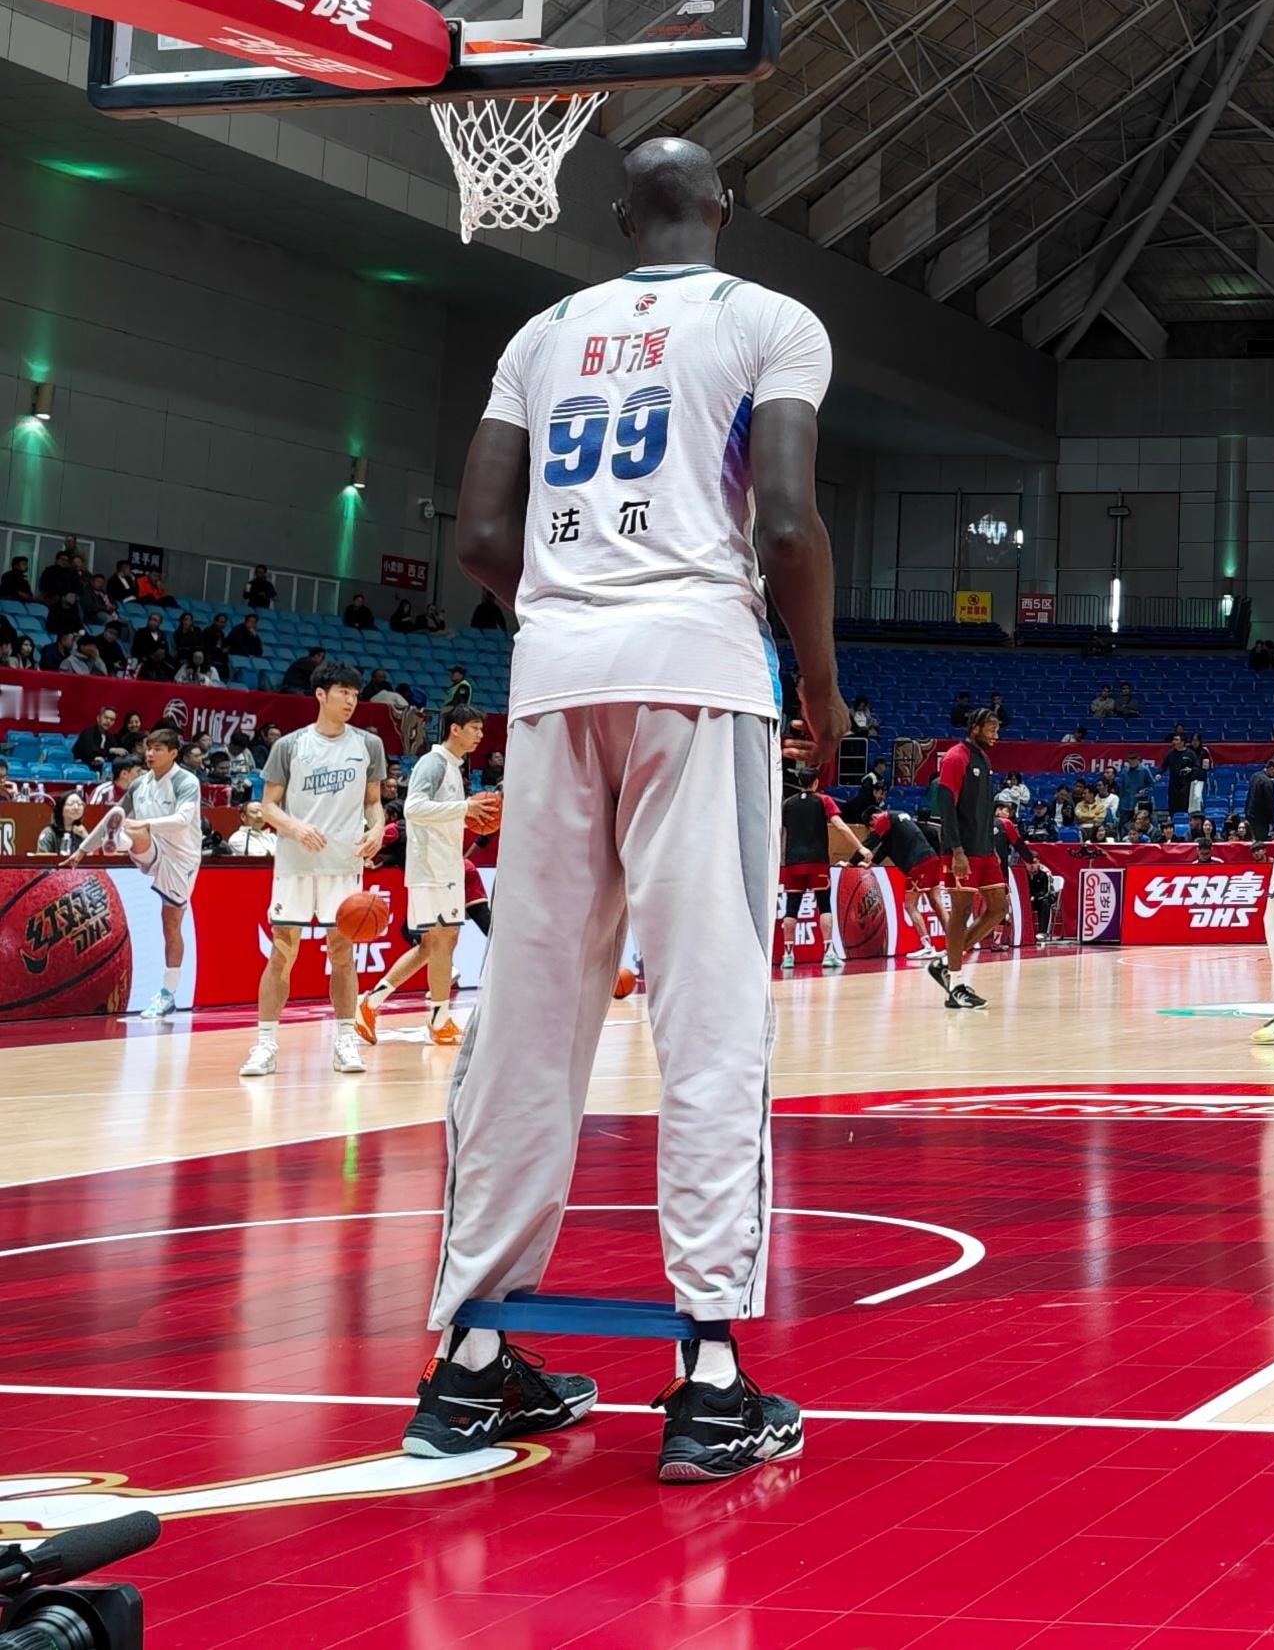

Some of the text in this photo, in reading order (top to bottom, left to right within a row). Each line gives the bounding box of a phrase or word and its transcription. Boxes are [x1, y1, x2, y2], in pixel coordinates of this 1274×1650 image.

[580, 326, 671, 377] 町渥
[543, 385, 672, 488] 99
[548, 500, 650, 545] 法尔
[1021, 598, 1053, 609] 西5区
[304, 768, 355, 791] NINGBO
[1100, 882, 1111, 923] 百岁山
[1134, 871, 1265, 918] 红双喜
[1188, 908, 1259, 928] DHS
